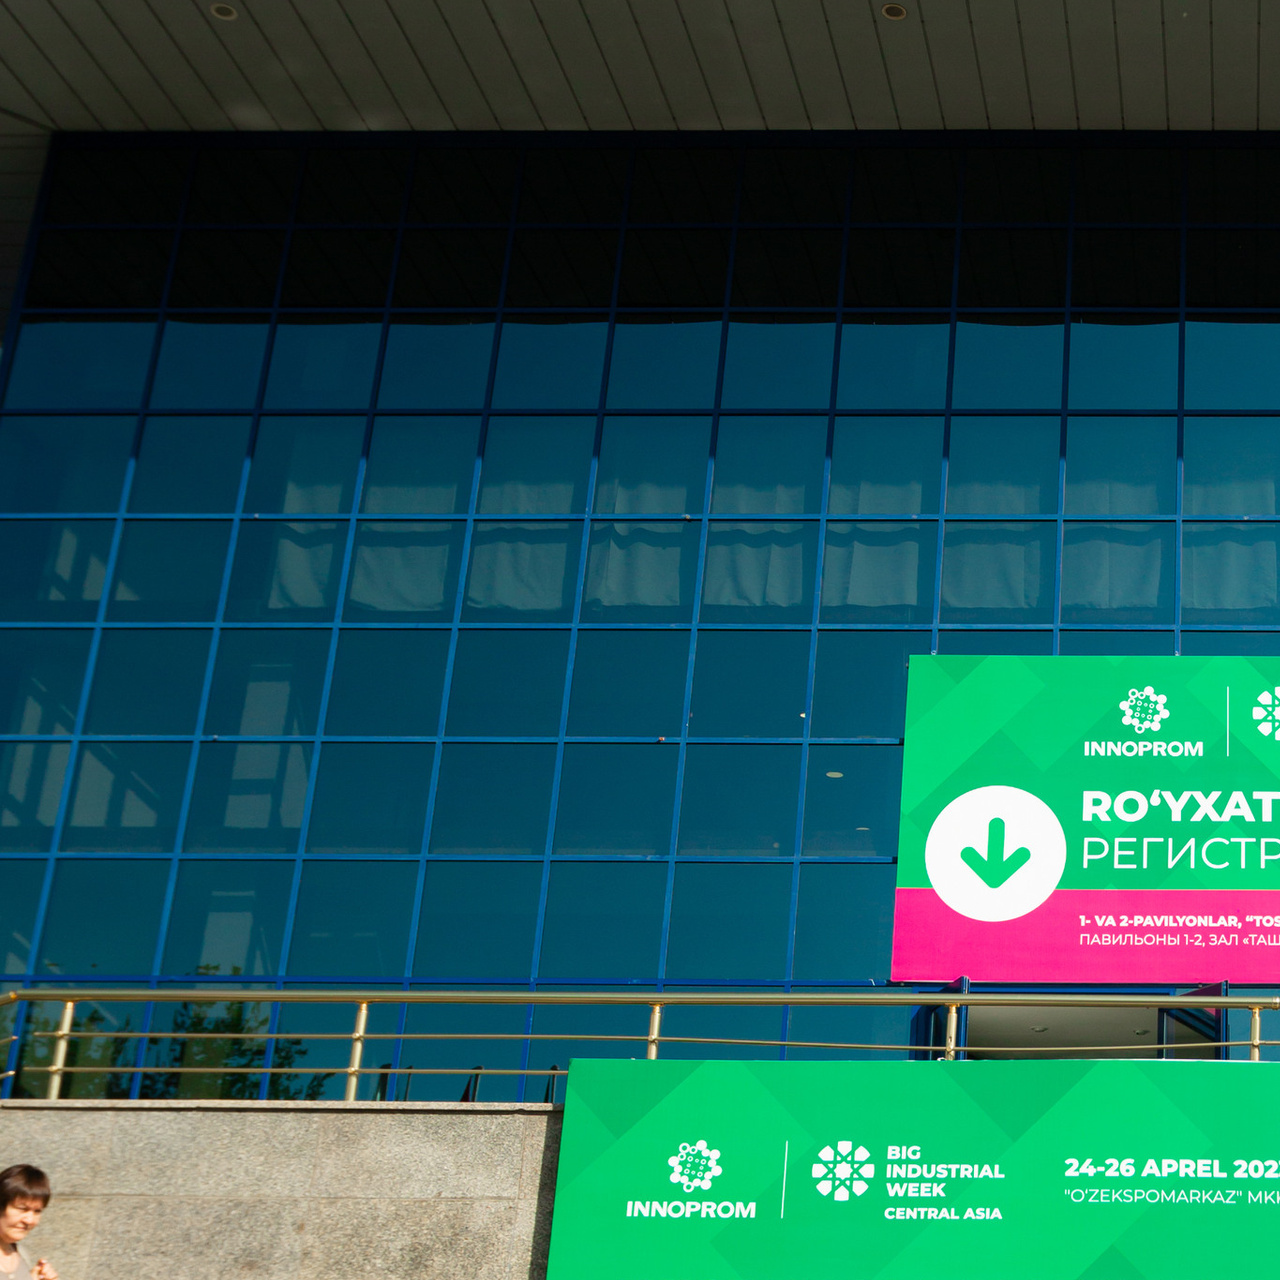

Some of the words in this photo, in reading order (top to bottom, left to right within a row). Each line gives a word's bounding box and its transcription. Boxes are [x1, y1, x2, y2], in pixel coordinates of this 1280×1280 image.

[1083, 740, 1204, 758] INNOPROM
[1078, 915, 1092, 927] 1-
[1094, 915, 1117, 927] VA
[1118, 915, 1243, 930] 2-PAVILYONLAR,
[1079, 933, 1180, 946] ПАВИЛЬОНЫ
[1183, 933, 1206, 948] 1-2,
[1208, 933, 1239, 946] ЗАЛ
[886, 1145, 921, 1160] BIG
[886, 1163, 1006, 1180] INDUSTRIAL
[1064, 1157, 1136, 1178] 24-26
[1140, 1158, 1228, 1179] APREL
[885, 1182, 946, 1198] WEEK
[625, 1200, 757, 1219] INNOPROM
[884, 1206, 960, 1220] CENTRAL
[963, 1207, 1003, 1221] ASIA
